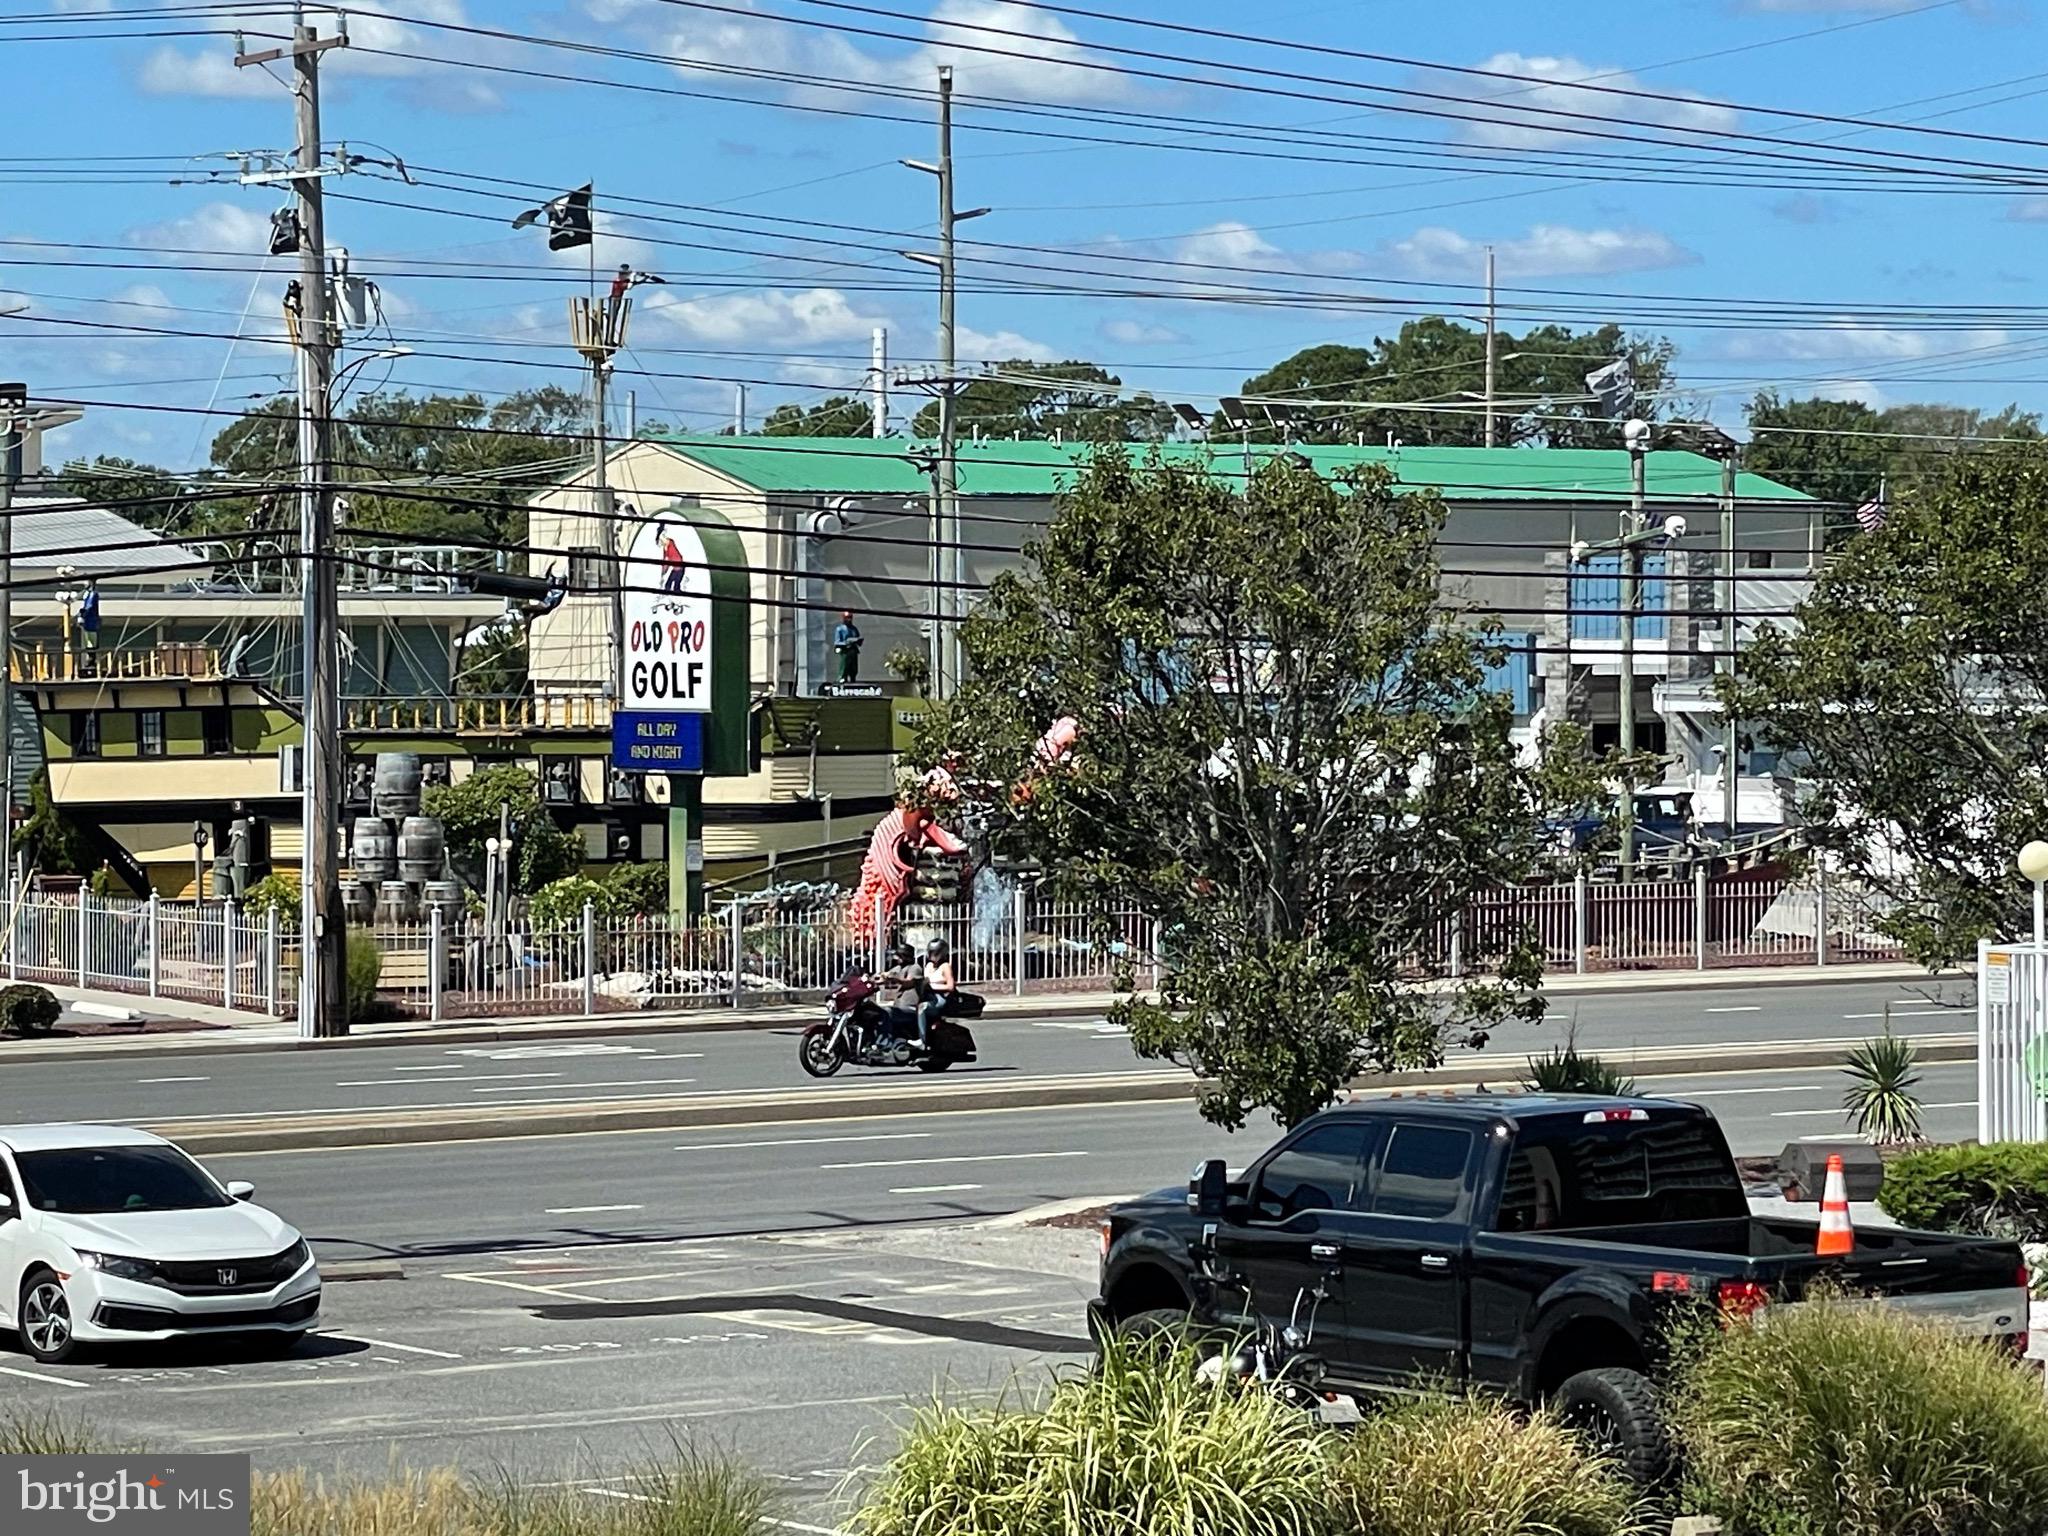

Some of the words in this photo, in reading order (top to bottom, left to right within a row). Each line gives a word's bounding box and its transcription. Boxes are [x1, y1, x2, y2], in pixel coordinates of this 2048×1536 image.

[631, 620, 662, 652] OLD
[668, 620, 705, 654] PRO
[632, 661, 704, 699] GOLF
[637, 723, 654, 737] ALL
[657, 723, 677, 737] DAY
[631, 745, 651, 759] AND
[652, 745, 683, 759] NIGHT
[234, 800, 241, 811] 3
